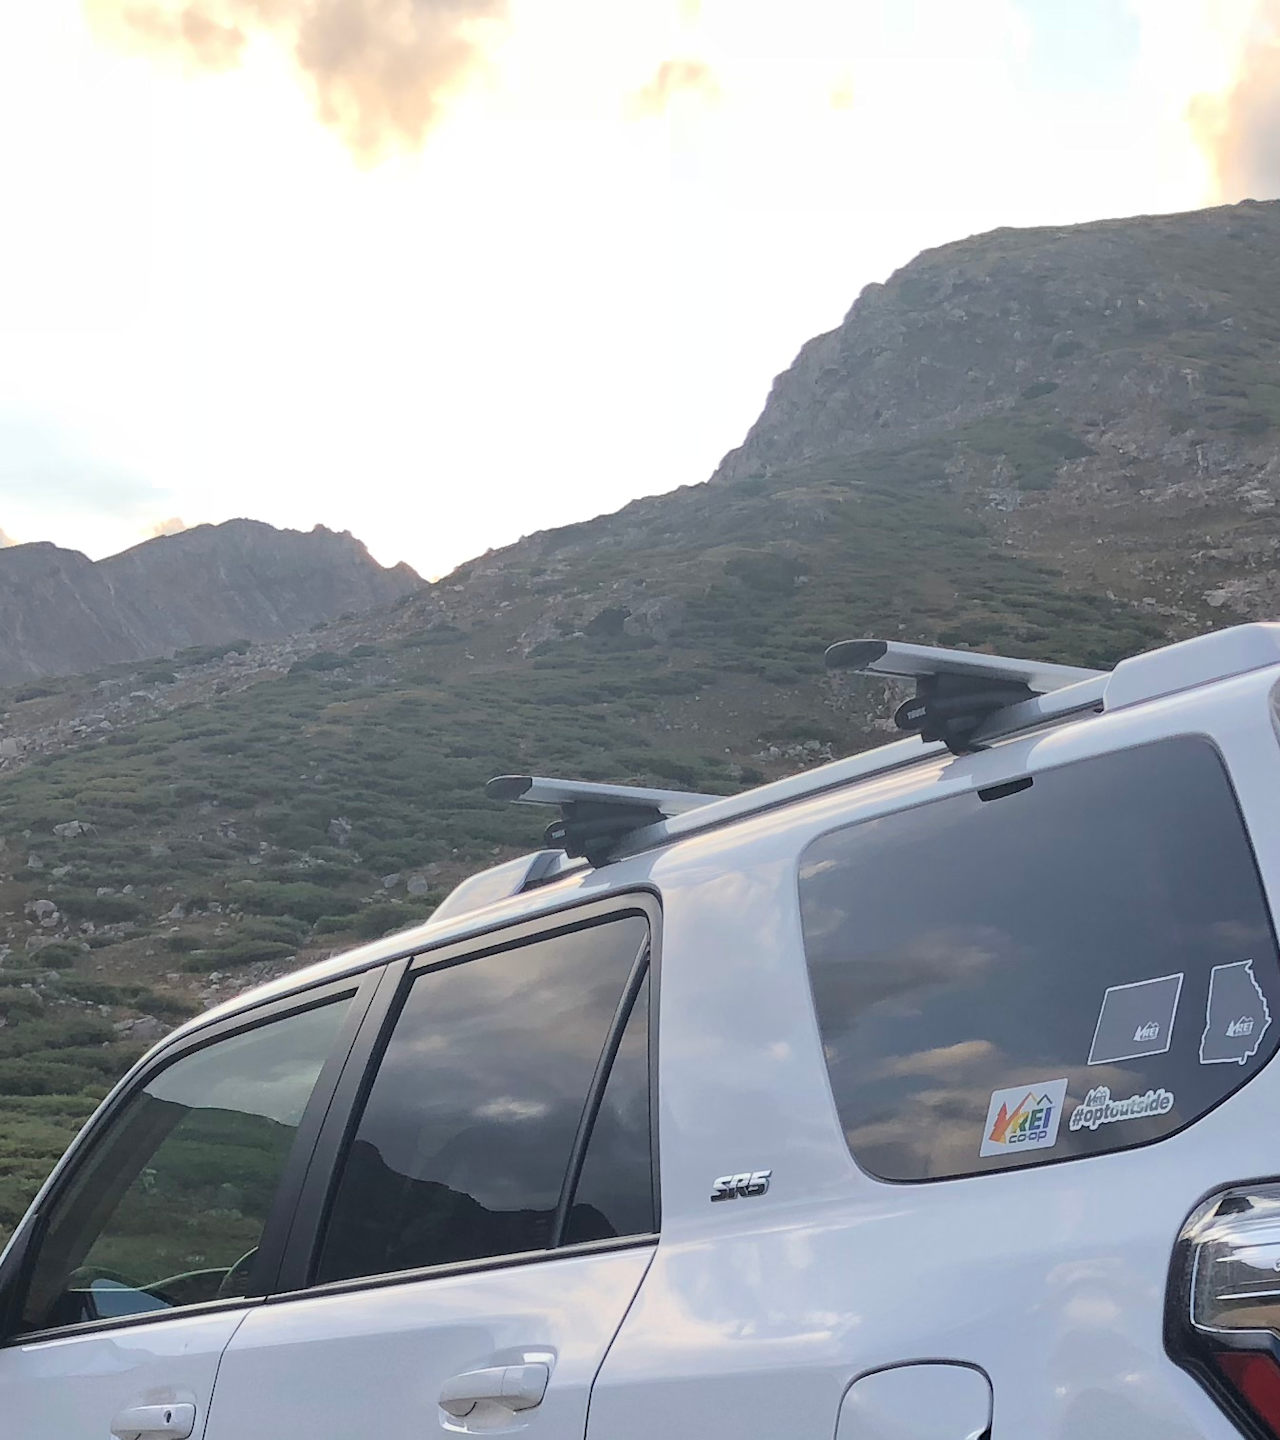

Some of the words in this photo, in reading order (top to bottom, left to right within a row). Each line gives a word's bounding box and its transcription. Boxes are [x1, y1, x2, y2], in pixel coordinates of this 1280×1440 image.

[1011, 1106, 1052, 1134] REI
[1072, 1092, 1170, 1127] #optoutside
[711, 1169, 772, 1202] SR5
